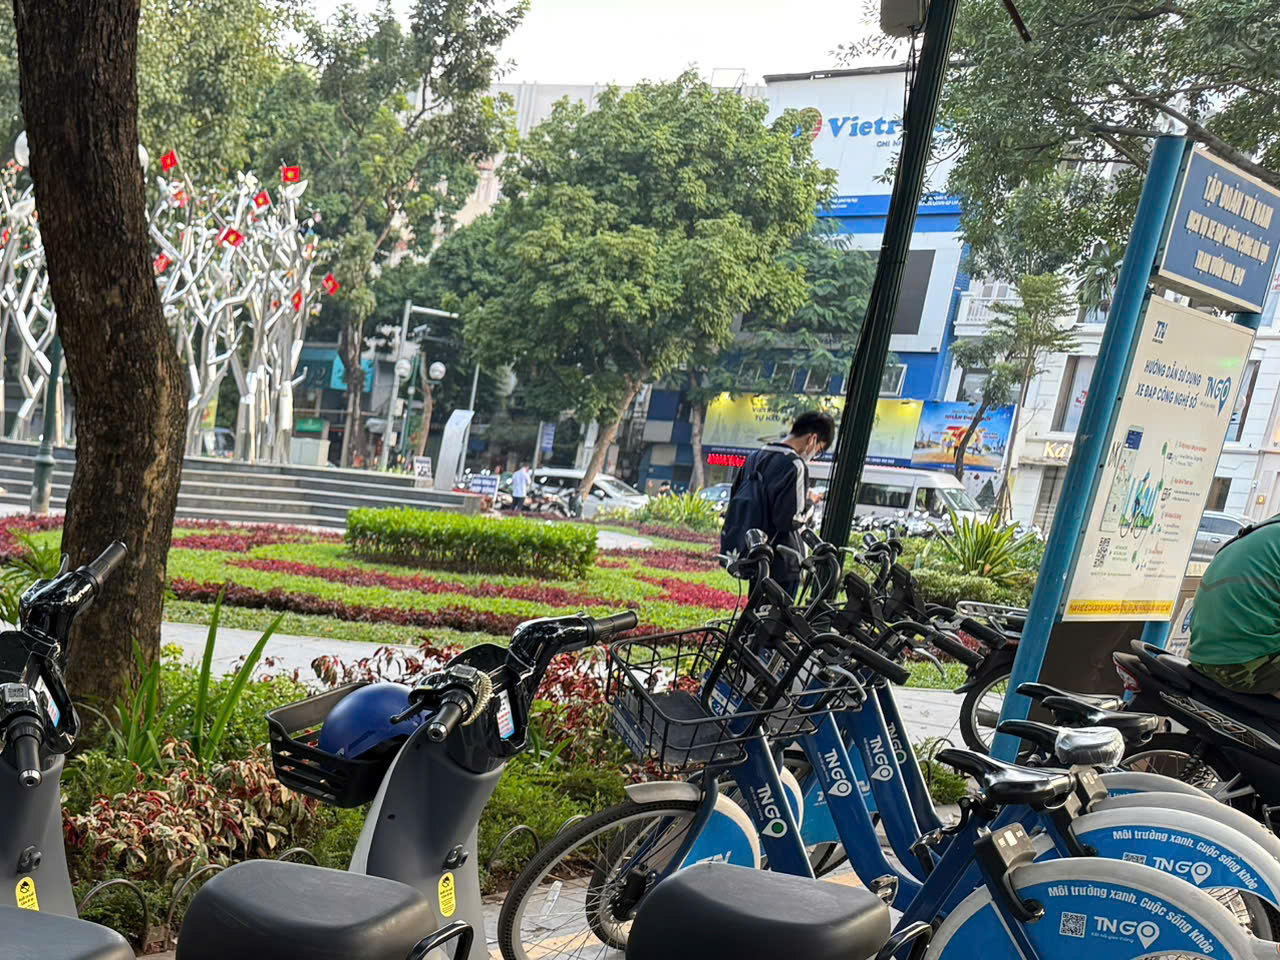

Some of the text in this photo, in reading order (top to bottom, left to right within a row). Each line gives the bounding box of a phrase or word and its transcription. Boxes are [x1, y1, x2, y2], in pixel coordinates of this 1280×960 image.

[1144, 358, 1166, 377] HƯỚNG
[1136, 382, 1145, 396] XE
[1144, 385, 1157, 402] ĐẠP
[1156, 386, 1173, 403] CÔNG
[1112, 829, 1132, 840] Môi
[1134, 829, 1168, 842] trường
[1169, 833, 1194, 848] xanh.
[1196, 841, 1220, 858] Cuộc
[1217, 854, 1241, 872] sống
[1048, 884, 1215, 955] Môi trường xanh. Cuộc sống khỏe
